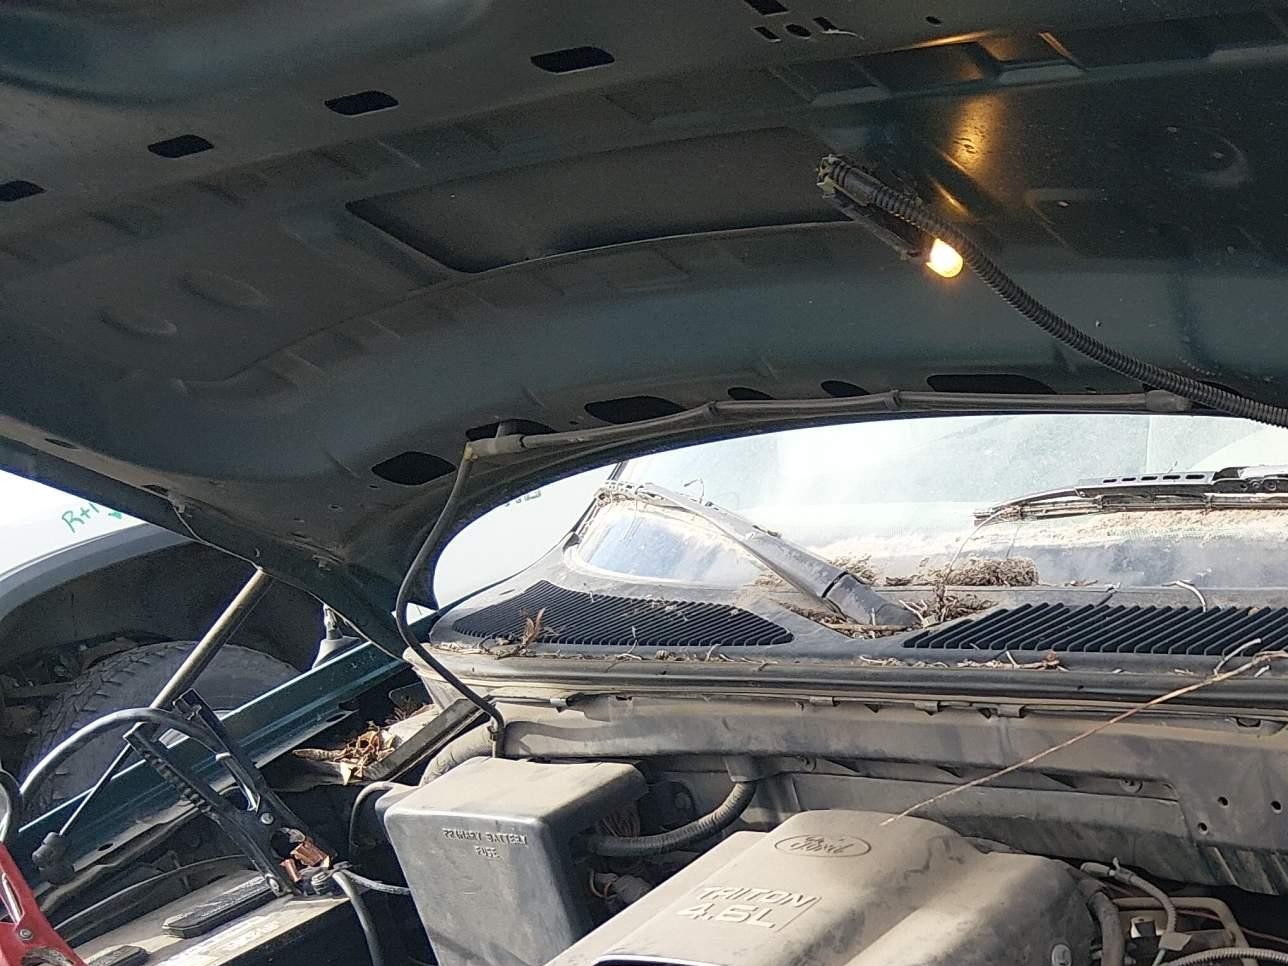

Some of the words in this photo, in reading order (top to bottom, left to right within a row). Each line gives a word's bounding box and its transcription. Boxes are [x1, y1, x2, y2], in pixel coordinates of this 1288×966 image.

[485, 832, 528, 846] BATTERY
[698, 886, 818, 908] TRITON
[676, 902, 776, 928] 4.6L
